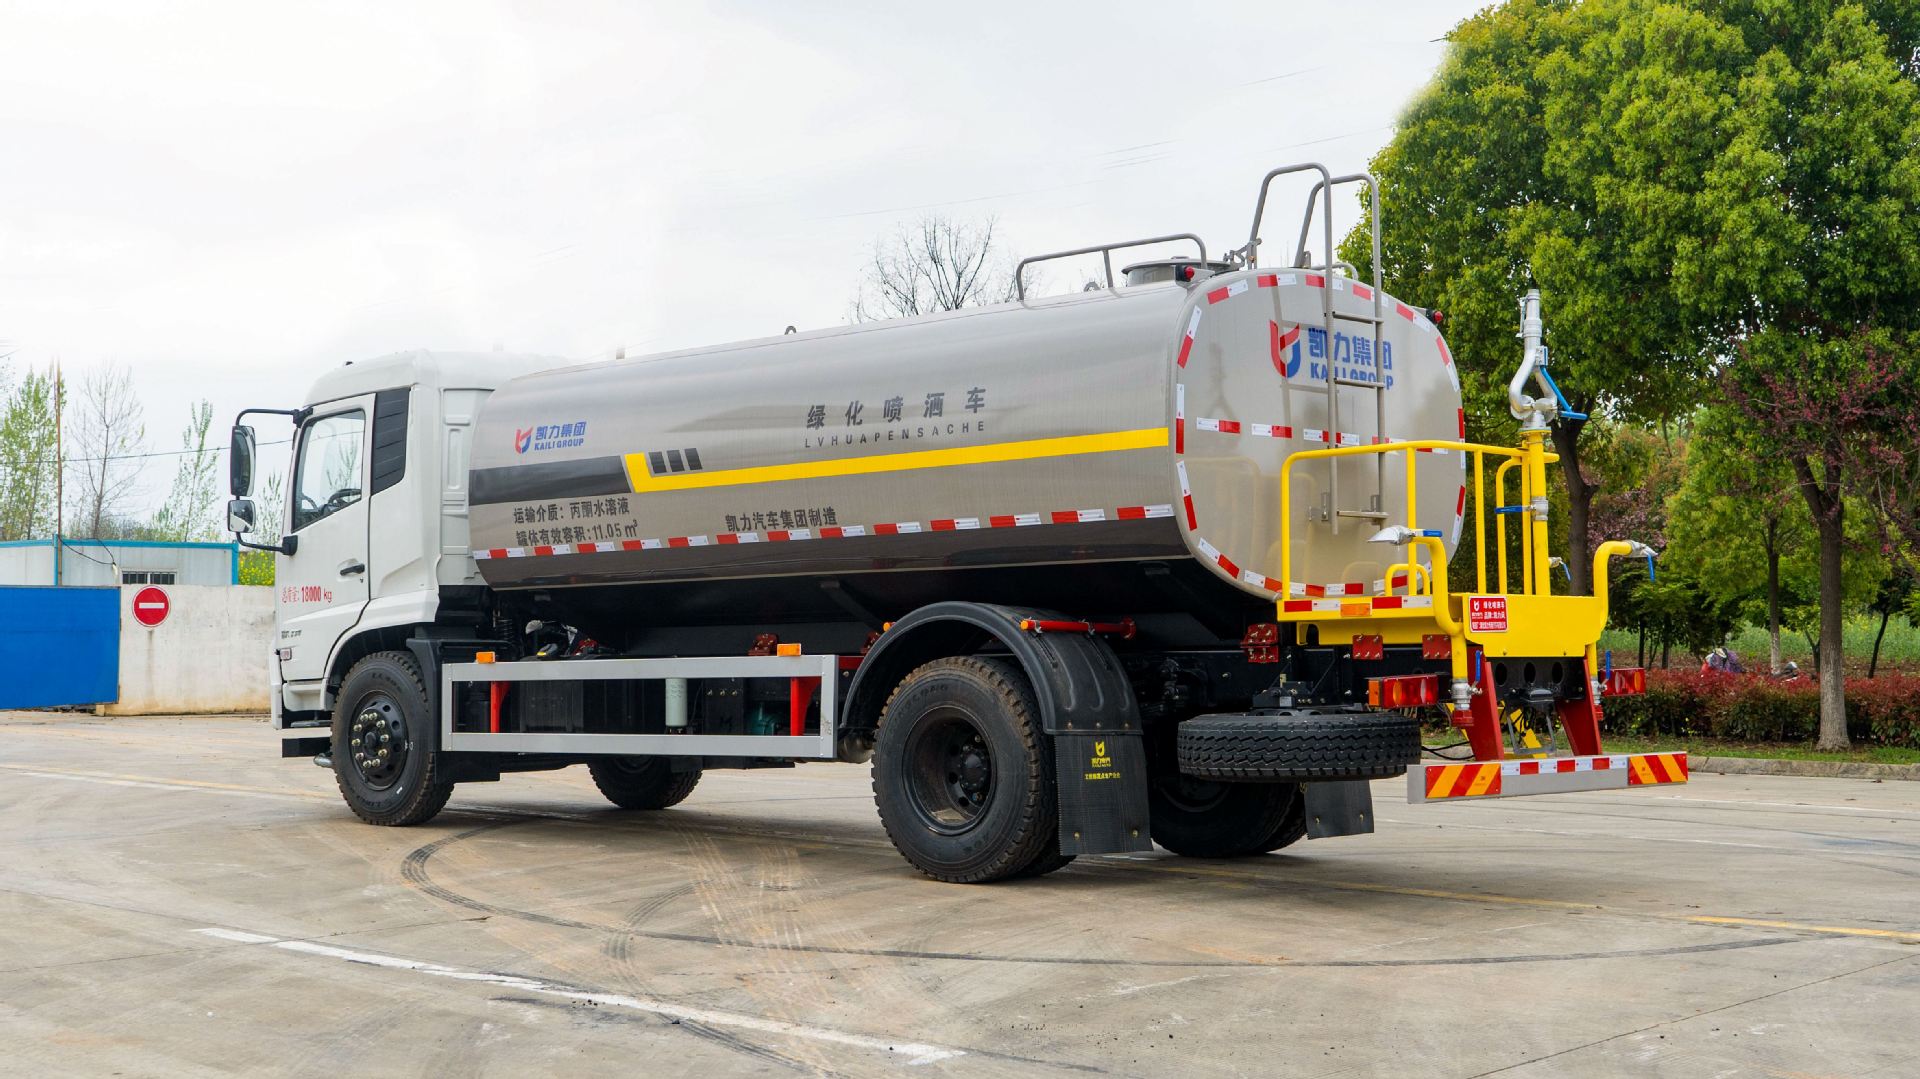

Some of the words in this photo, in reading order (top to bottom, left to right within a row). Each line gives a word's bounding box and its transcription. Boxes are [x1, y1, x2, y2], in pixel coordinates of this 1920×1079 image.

[1308, 328, 1392, 370] 凯力集团
[806, 386, 986, 430] 绿化喷洒车
[535, 421, 586, 441] 凯力集团
[804, 420, 984, 448] LVHUAPENSACHE
[725, 506, 838, 532] 凯力汽车集团制造
